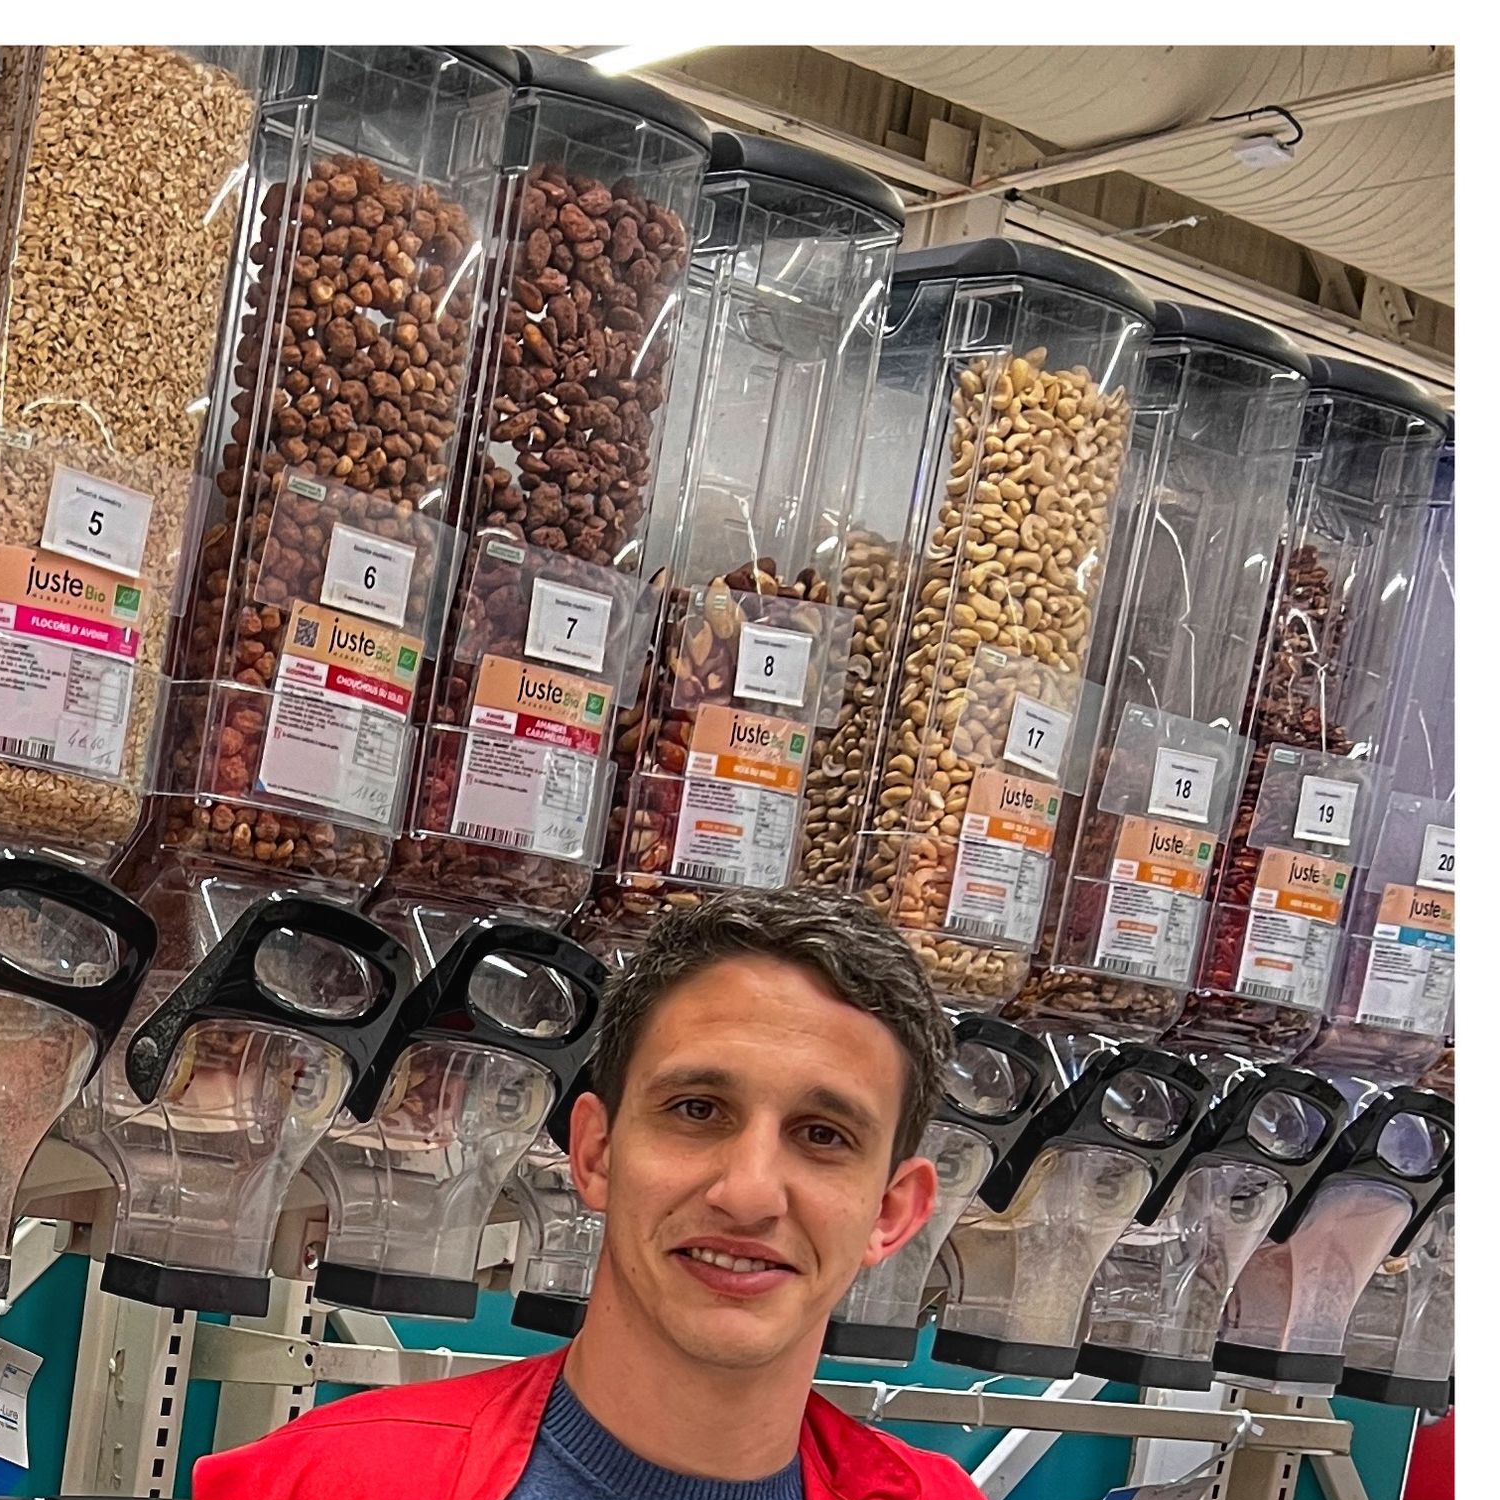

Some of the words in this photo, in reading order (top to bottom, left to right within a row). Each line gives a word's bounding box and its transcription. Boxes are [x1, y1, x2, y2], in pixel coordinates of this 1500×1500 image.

[87, 510, 105, 536] 5
[26, 557, 84, 599] juste
[85, 586, 106, 603] Bio
[363, 565, 377, 589] 6
[30, 616, 72, 634] FLOCONS
[72, 624, 109, 642] D'AVOINE
[328, 617, 376, 658] juste
[566, 617, 579, 640] 7
[764, 655, 775, 677] 8
[517, 668, 563, 705] juste
[730, 714, 771, 747] juste
[1026, 727, 1045, 750] 17
[999, 778, 1034, 810] juste
[1174, 778, 1192, 799] 18
[1318, 803, 1335, 824] 19
[1149, 827, 1184, 855] juste
[1288, 856, 1320, 884] juste
[1437, 853, 1455, 872] 20
[1409, 892, 1441, 919] juste
